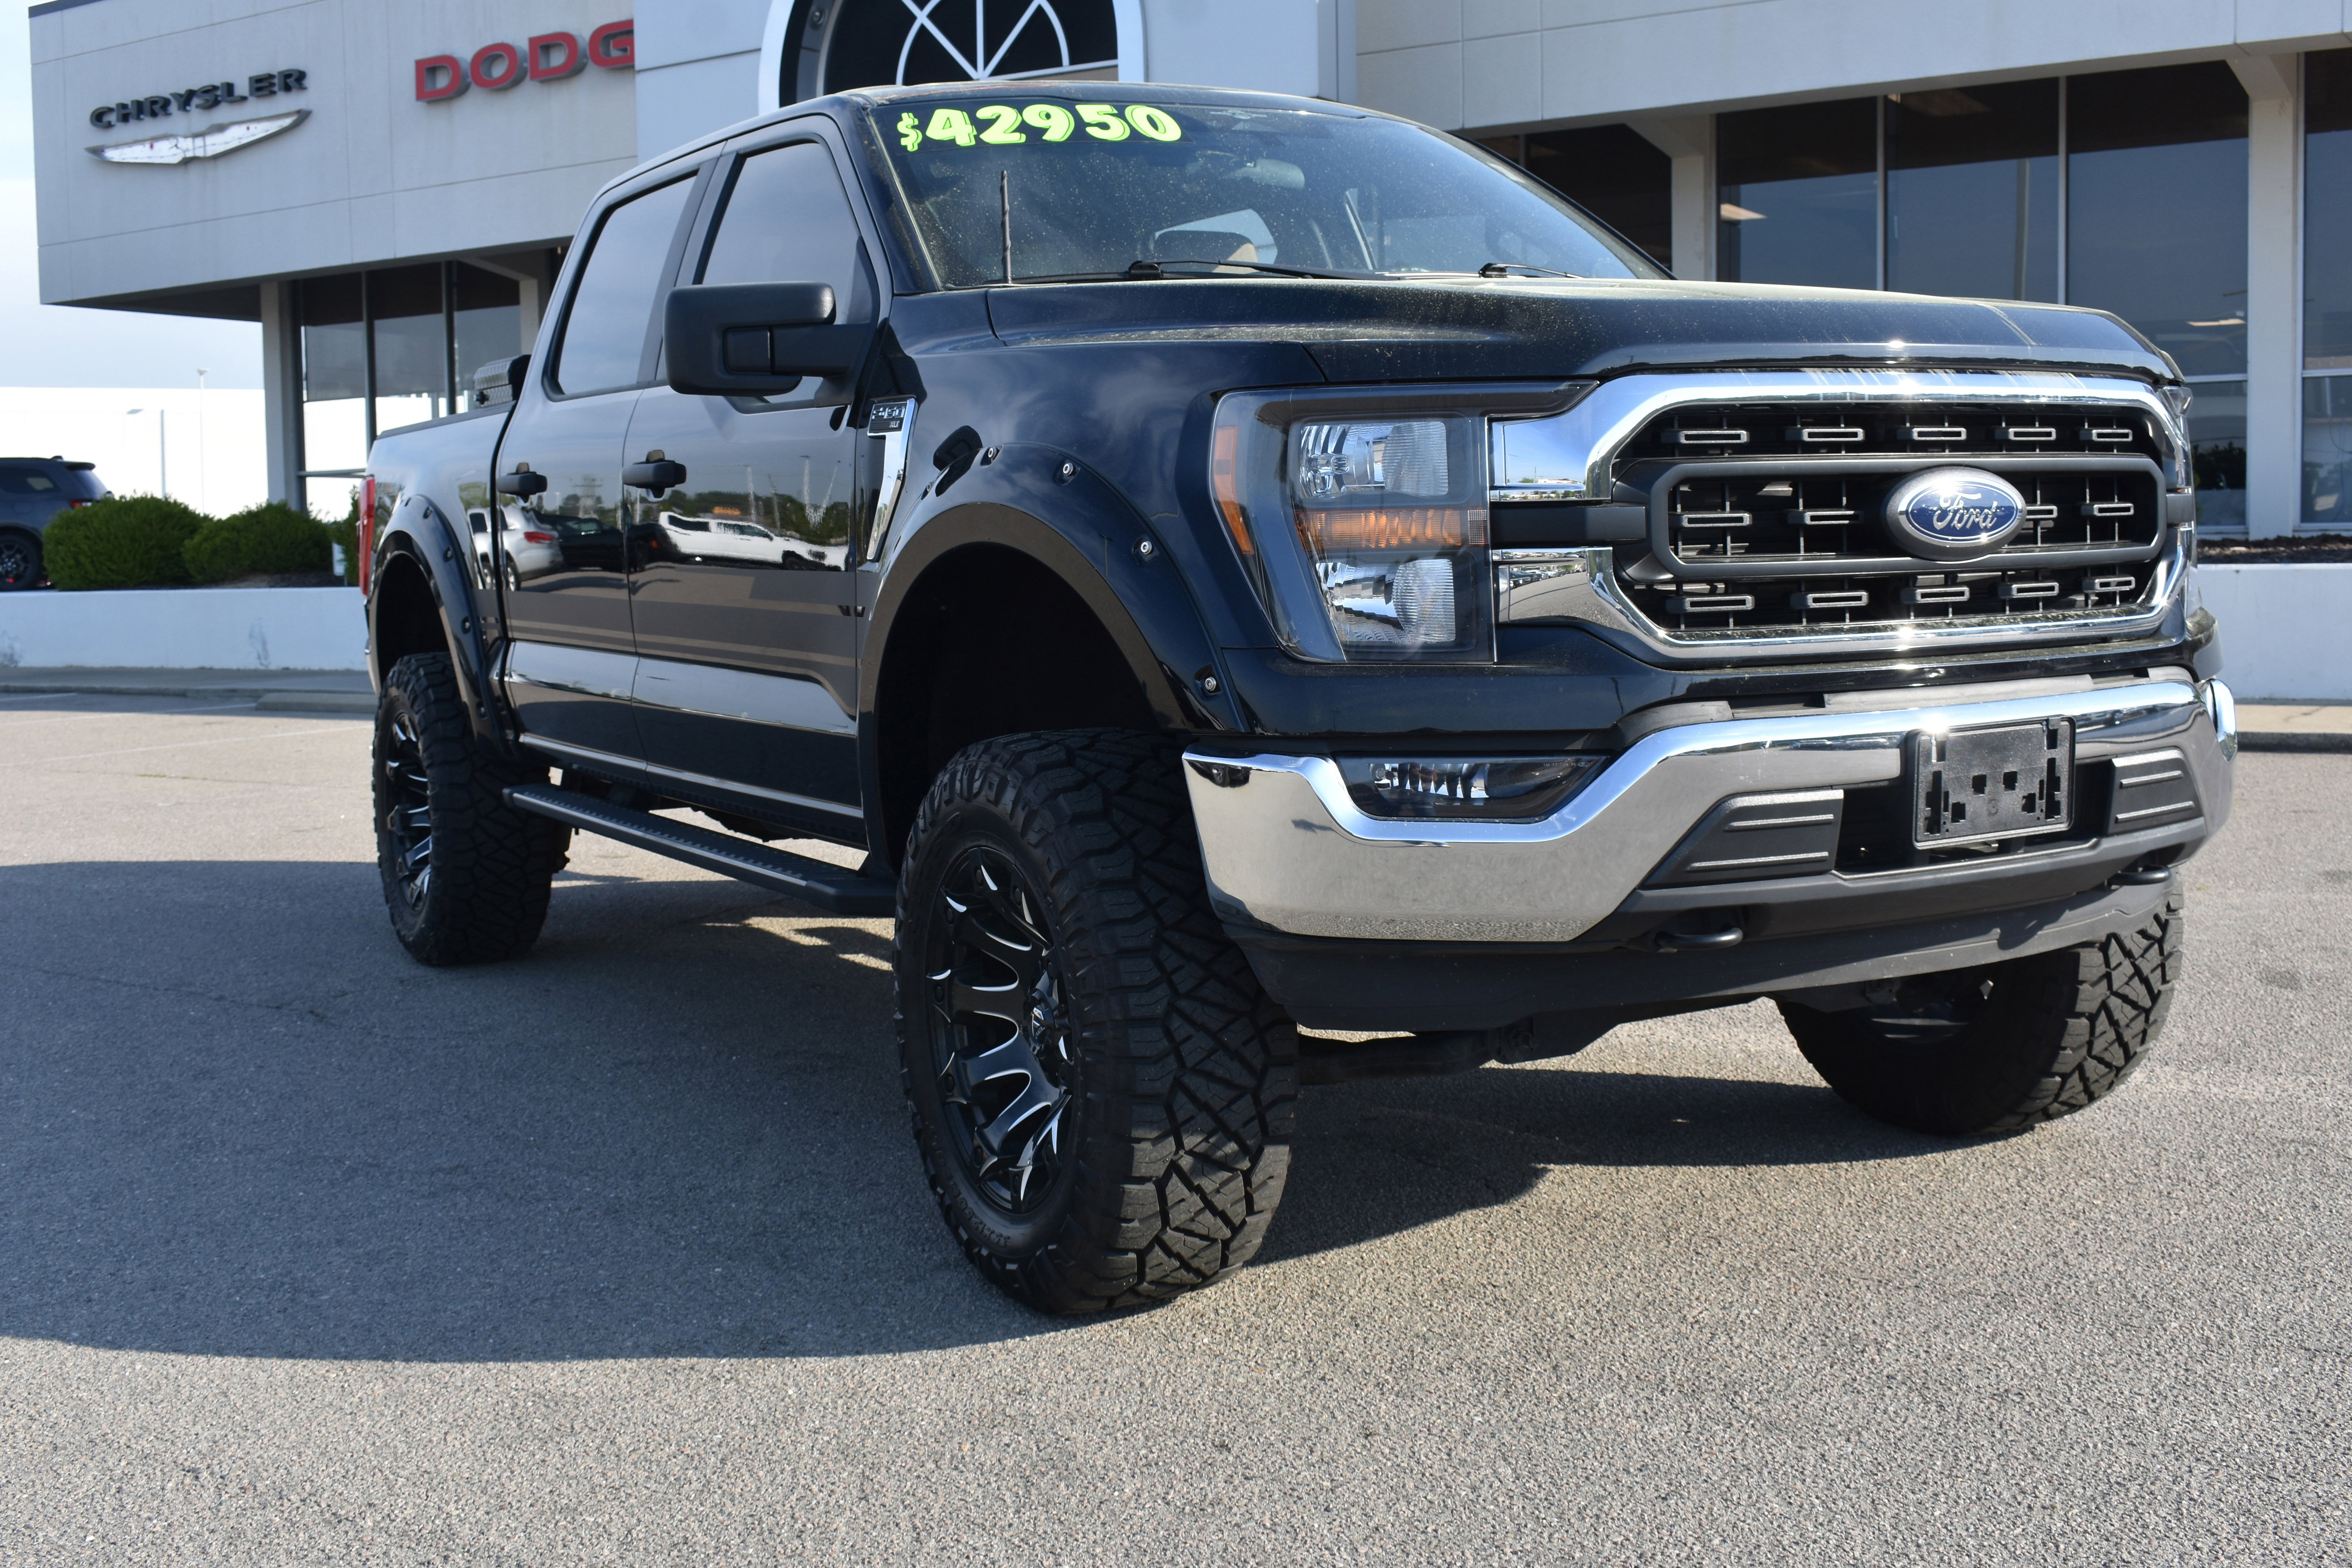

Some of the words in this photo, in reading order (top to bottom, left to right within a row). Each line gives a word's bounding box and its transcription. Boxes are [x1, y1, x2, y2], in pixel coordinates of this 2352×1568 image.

[89, 68, 308, 128] CHRYSLER
[897, 104, 1182, 151] $42950
[1933, 491, 1997, 530] Ford
